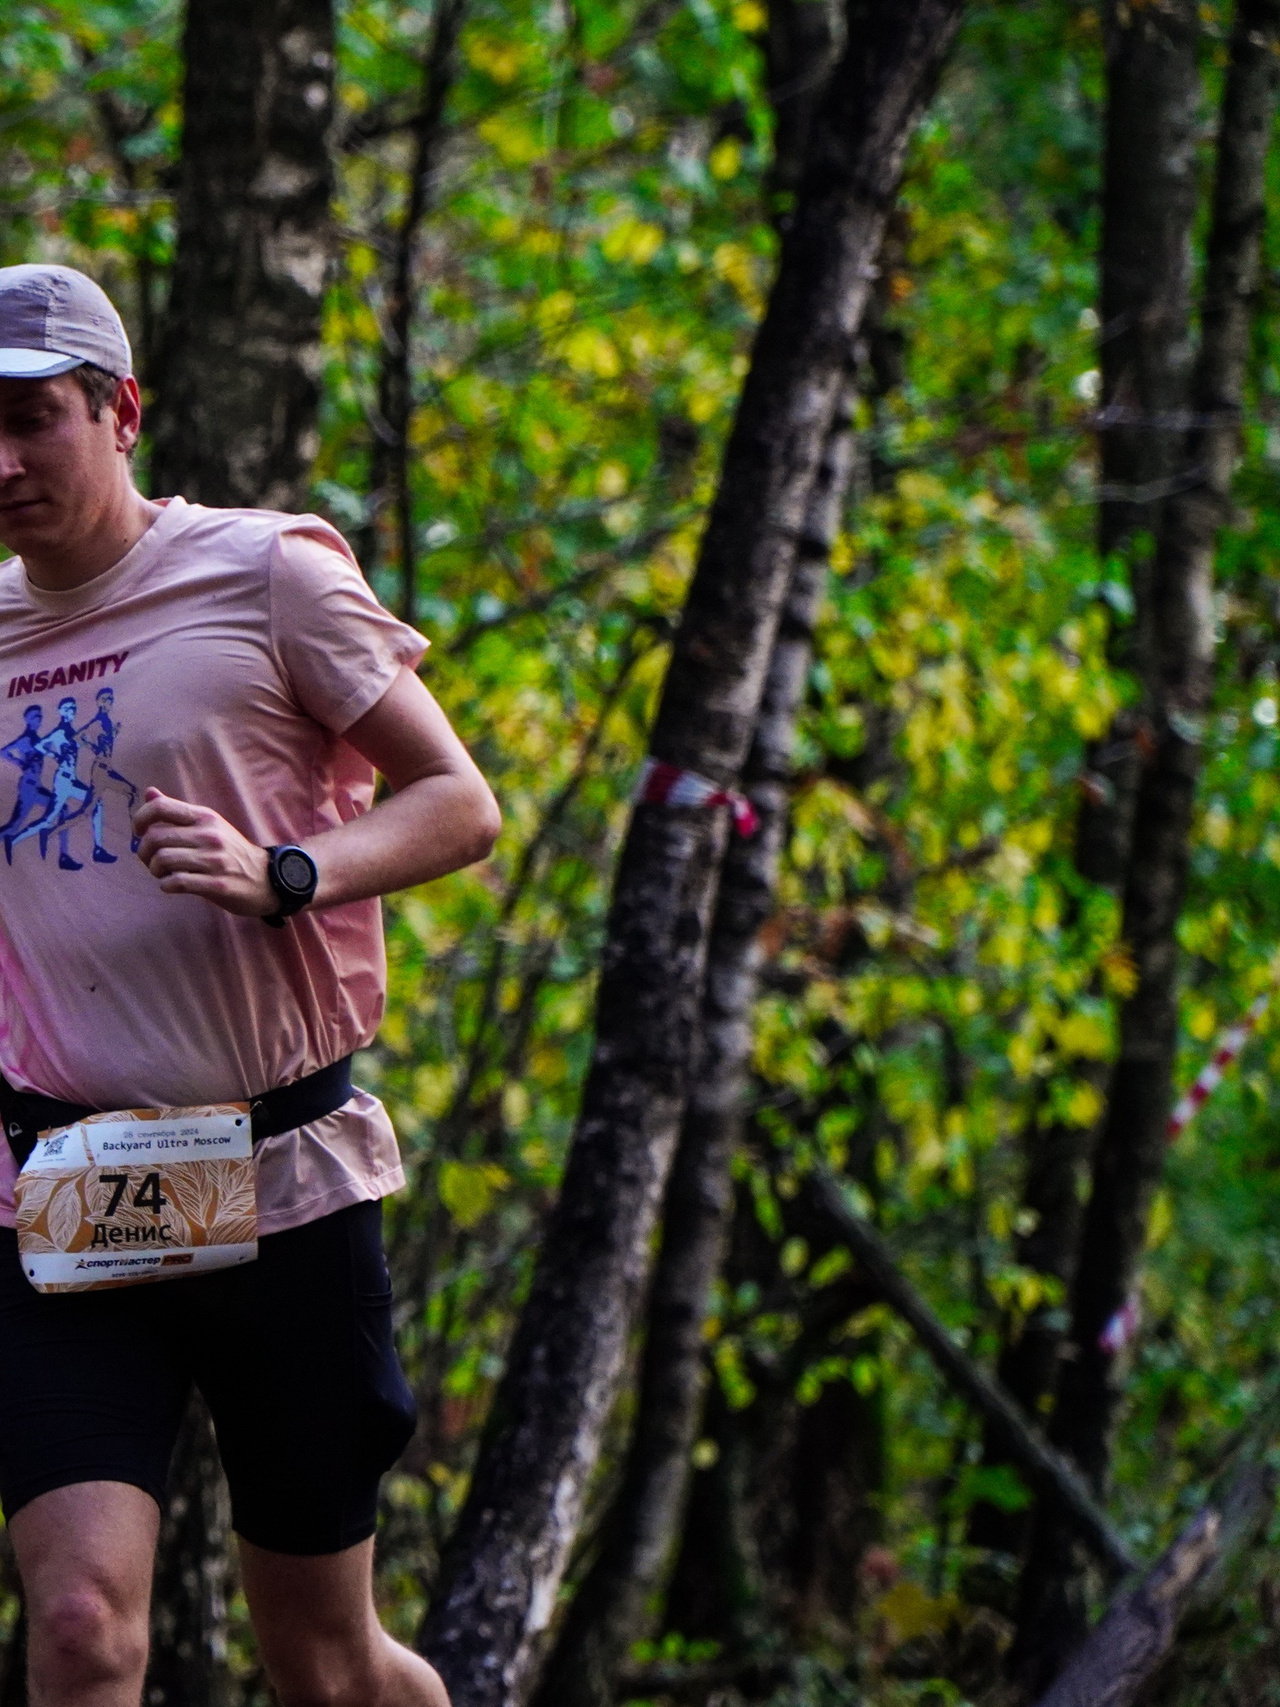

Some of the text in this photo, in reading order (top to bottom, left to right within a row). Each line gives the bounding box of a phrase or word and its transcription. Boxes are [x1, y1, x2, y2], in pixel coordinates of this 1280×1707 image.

[6, 651, 130, 698] INSANITY
[102, 1136, 231, 1152] Backyard Ultra Moscow
[99, 1172, 167, 1217] 74
[91, 1223, 173, 1249] Денис
